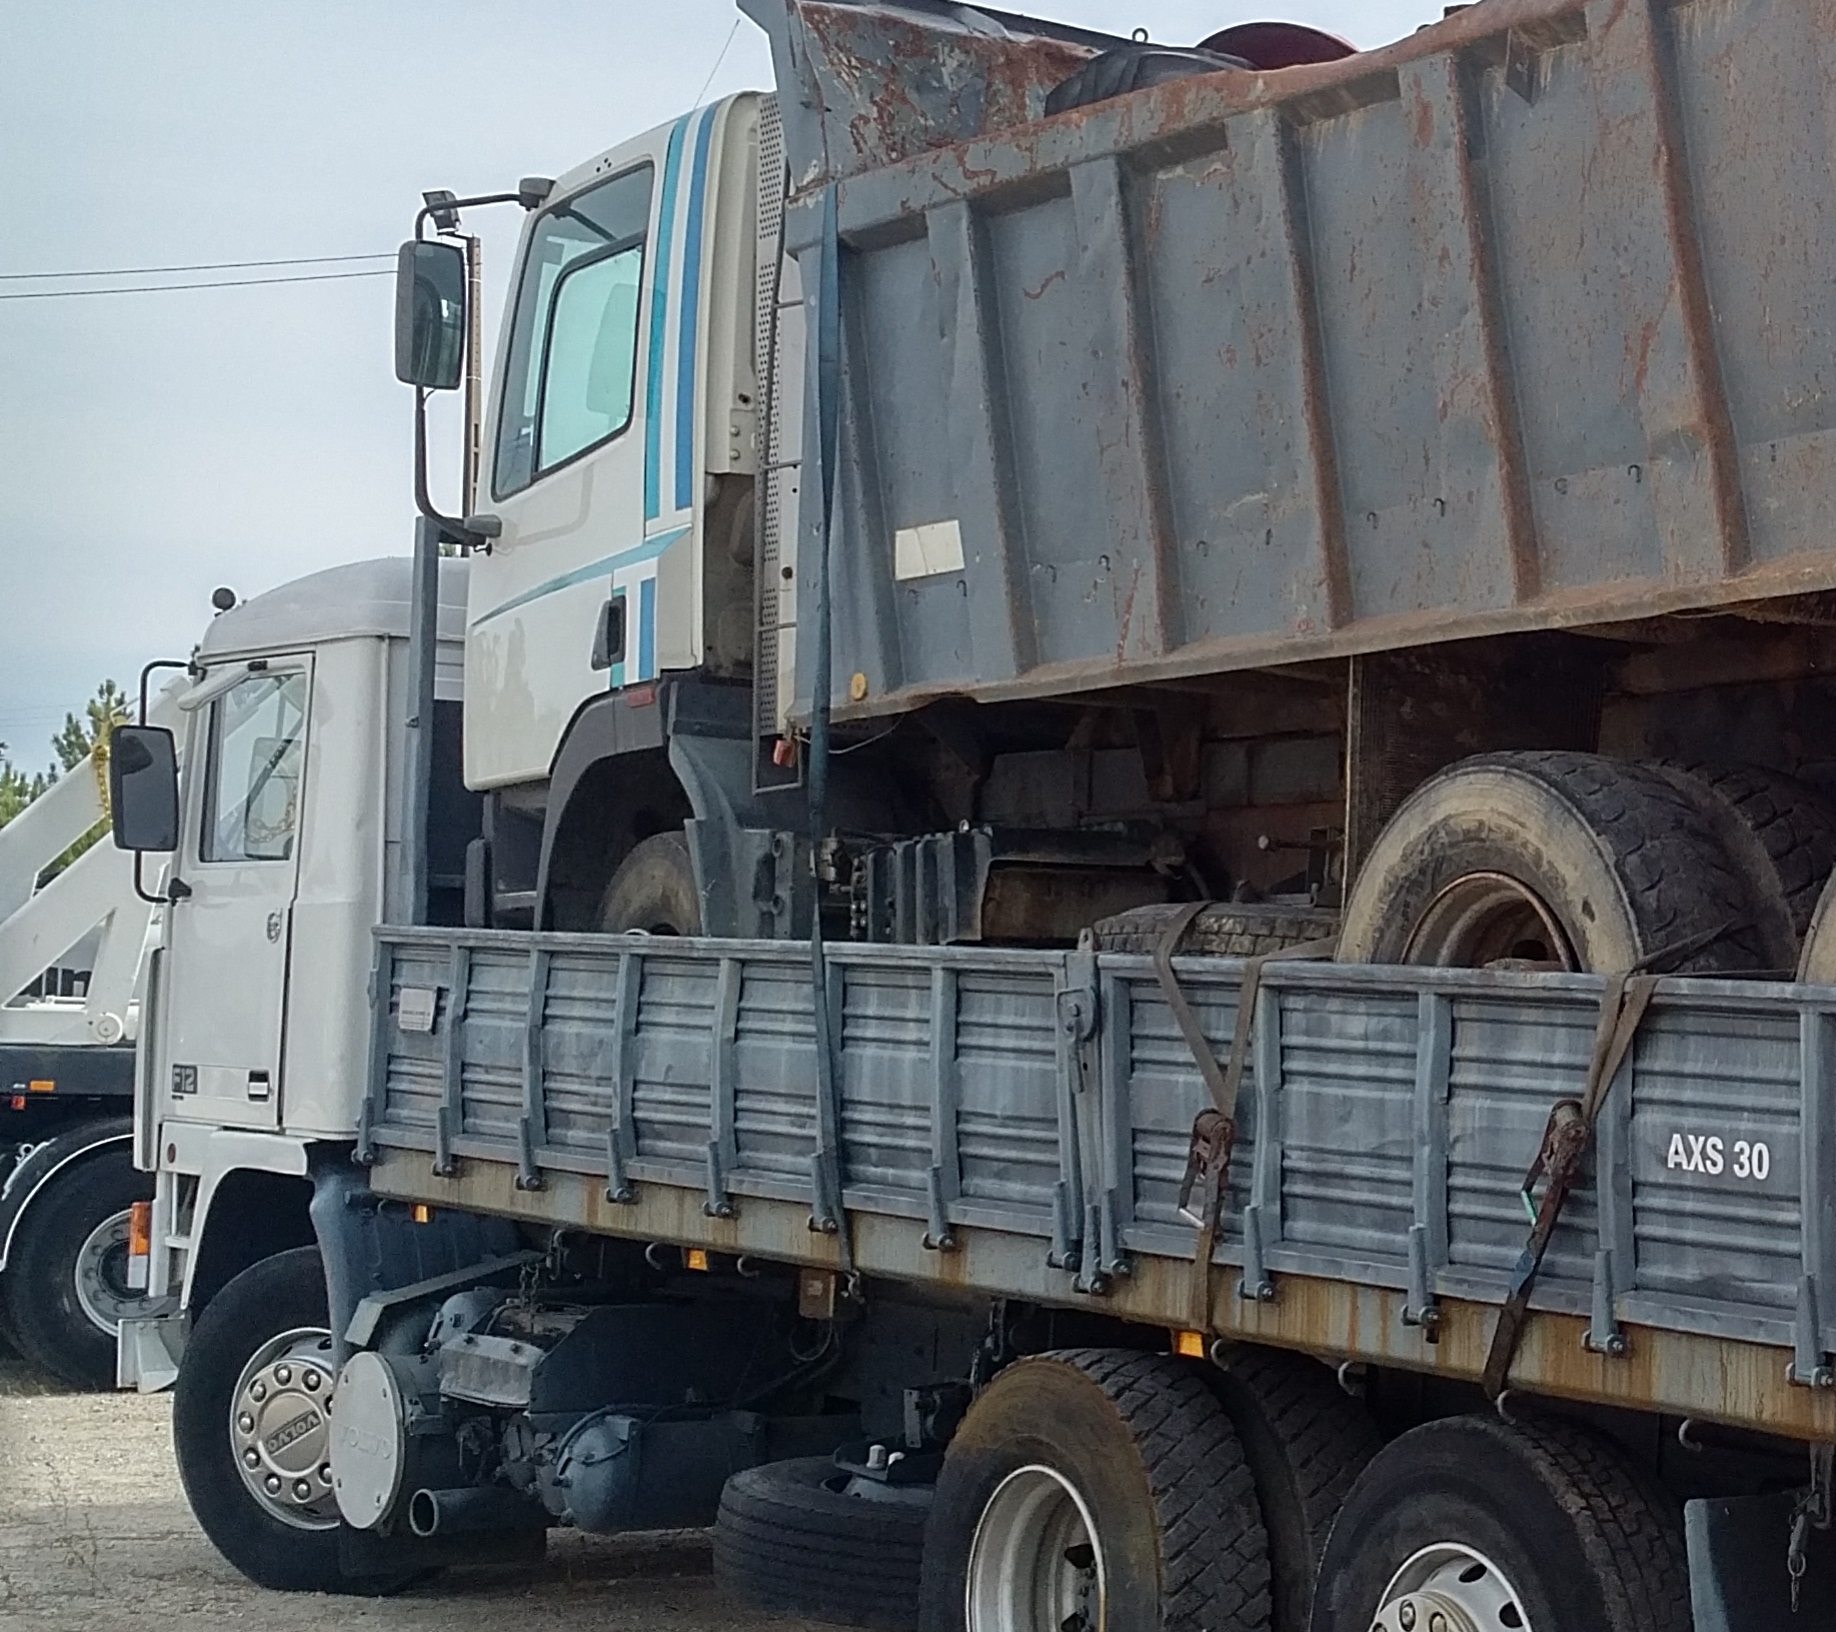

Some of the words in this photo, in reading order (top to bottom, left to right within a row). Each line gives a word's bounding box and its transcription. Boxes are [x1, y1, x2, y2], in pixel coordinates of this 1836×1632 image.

[1667, 1133, 1724, 1175] AXS
[1733, 1140, 1770, 1180] 30
[266, 1413, 319, 1451] VOLVO
